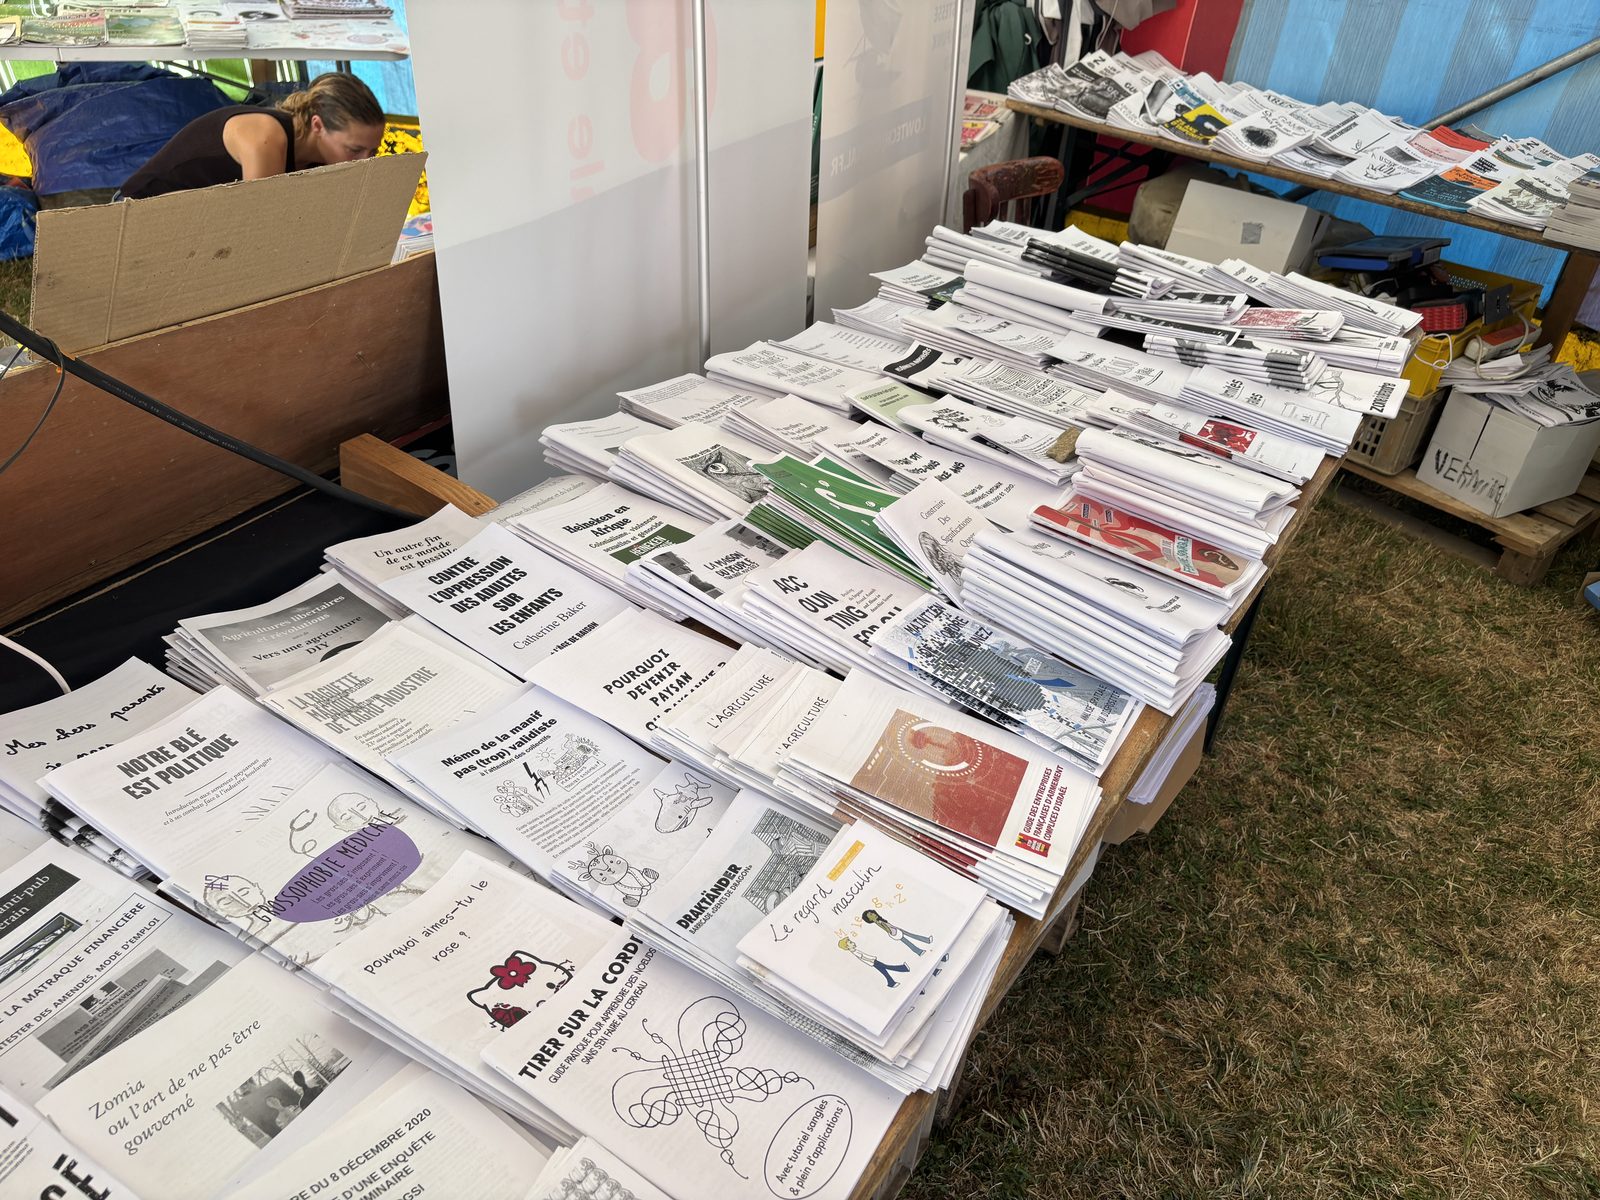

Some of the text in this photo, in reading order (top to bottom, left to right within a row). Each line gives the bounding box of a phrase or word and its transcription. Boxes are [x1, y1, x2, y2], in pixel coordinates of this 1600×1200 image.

[562, 504, 631, 534] Heineken en
[590, 517, 632, 537] Afrique
[920, 499, 945, 520] Construire
[937, 514, 951, 525] Des
[373, 534, 442, 558] Un autre fin
[386, 540, 452, 566] de ce monde
[400, 562, 416, 572] est
[427, 556, 480, 585] CONTRE
[428, 555, 513, 604] L'OPPRESSION
[450, 567, 527, 614] DES ADULTES
[772, 575, 808, 594] ACC
[221, 595, 345, 642] Agricultures libertaires
[488, 587, 564, 636] LES ENFANTS
[492, 592, 524, 612] SUR
[512, 601, 587, 650] Catherine Baker
[798, 590, 839, 613] OUN
[823, 605, 869, 630] TING
[903, 601, 947, 636] MAINTIEN
[252, 651, 280, 661] Vers
[282, 642, 303, 653] une
[305, 615, 362, 645] agriculture
[306, 641, 329, 655] DIY
[575, 621, 599, 639] RAISON
[603, 648, 669, 694] POURQUOI
[627, 661, 681, 700] DEVENIR
[649, 671, 692, 707] PAYSAN
[5, 684, 166, 756] Mes chers parents
[706, 674, 775, 729] L'AGRICULTURE
[324, 721, 351, 734] DE
[441, 710, 543, 767] Mémo de la manif
[453, 718, 557, 779] pas (trop) validiste
[116, 745, 178, 778] NOTRE
[169, 726, 207, 754] BLÉ
[122, 776, 160, 800] EST
[155, 733, 239, 784] POLITIQUE
[484, 734, 551, 775] l'attention des collectifs
[1023, 767, 1053, 834] GUIDE DES ENTREPRISES
[1033, 803, 1050, 838] FRANÇAISES
[1044, 764, 1064, 805] D'ARMEMENT
[1043, 810, 1059, 841] COMPLICES
[252, 857, 346, 923] GROSSOPHOBIE
[675, 863, 742, 930] DRAKTÄNDER
[689, 912, 713, 935] BARRICADE
[724, 889, 734, 898] DE
[771, 883, 833, 942] Le regard
[831, 865, 882, 915] masculin
[364, 936, 420, 975] pourquoi
[470, 880, 488, 891] le
[432, 931, 471, 962] rose ?
[3, 1004, 23, 1017] LA
[22, 955, 85, 1004] MATRAQUE
[84, 902, 146, 955] FINANCIÈRE
[33, 1008, 52, 1023] DES
[53, 975, 98, 1009] AMENDES,
[96, 950, 123, 972] MODE
[121, 917, 161, 951] D'EMPLOI
[518, 1037, 565, 1080] TIRER
[557, 1009, 590, 1038] SUR
[582, 988, 608, 1009] LA
[548, 1063, 570, 1084] GUIDE
[564, 1036, 589, 1066] PRATIQUE
[587, 1020, 604, 1040] POUR
[602, 987, 630, 1024] APPRENDRE
[626, 973, 638, 989] DES
[581, 1048, 598, 1065] SANS
[603, 1019, 621, 1040] FAIRE
[617, 1010, 628, 1021] AU
[624, 980, 648, 1010] CERVEAU
[88, 1080, 146, 1120] Zomia
[108, 1020, 261, 1135] ou l'art de ne pas être
[124, 1093, 196, 1156] gouverné
[775, 1099, 828, 1184] Avec tutoriel sangles
[309, 1177, 330, 1194] DU
[329, 1172, 340, 1183] 8
[339, 1128, 407, 1176] DÉCEMBRE
[404, 1108, 432, 1132] 2020
[341, 1130, 437, 1200] D'UNE ENQUÊTE
[789, 1106, 844, 1196] & plein d'applications
